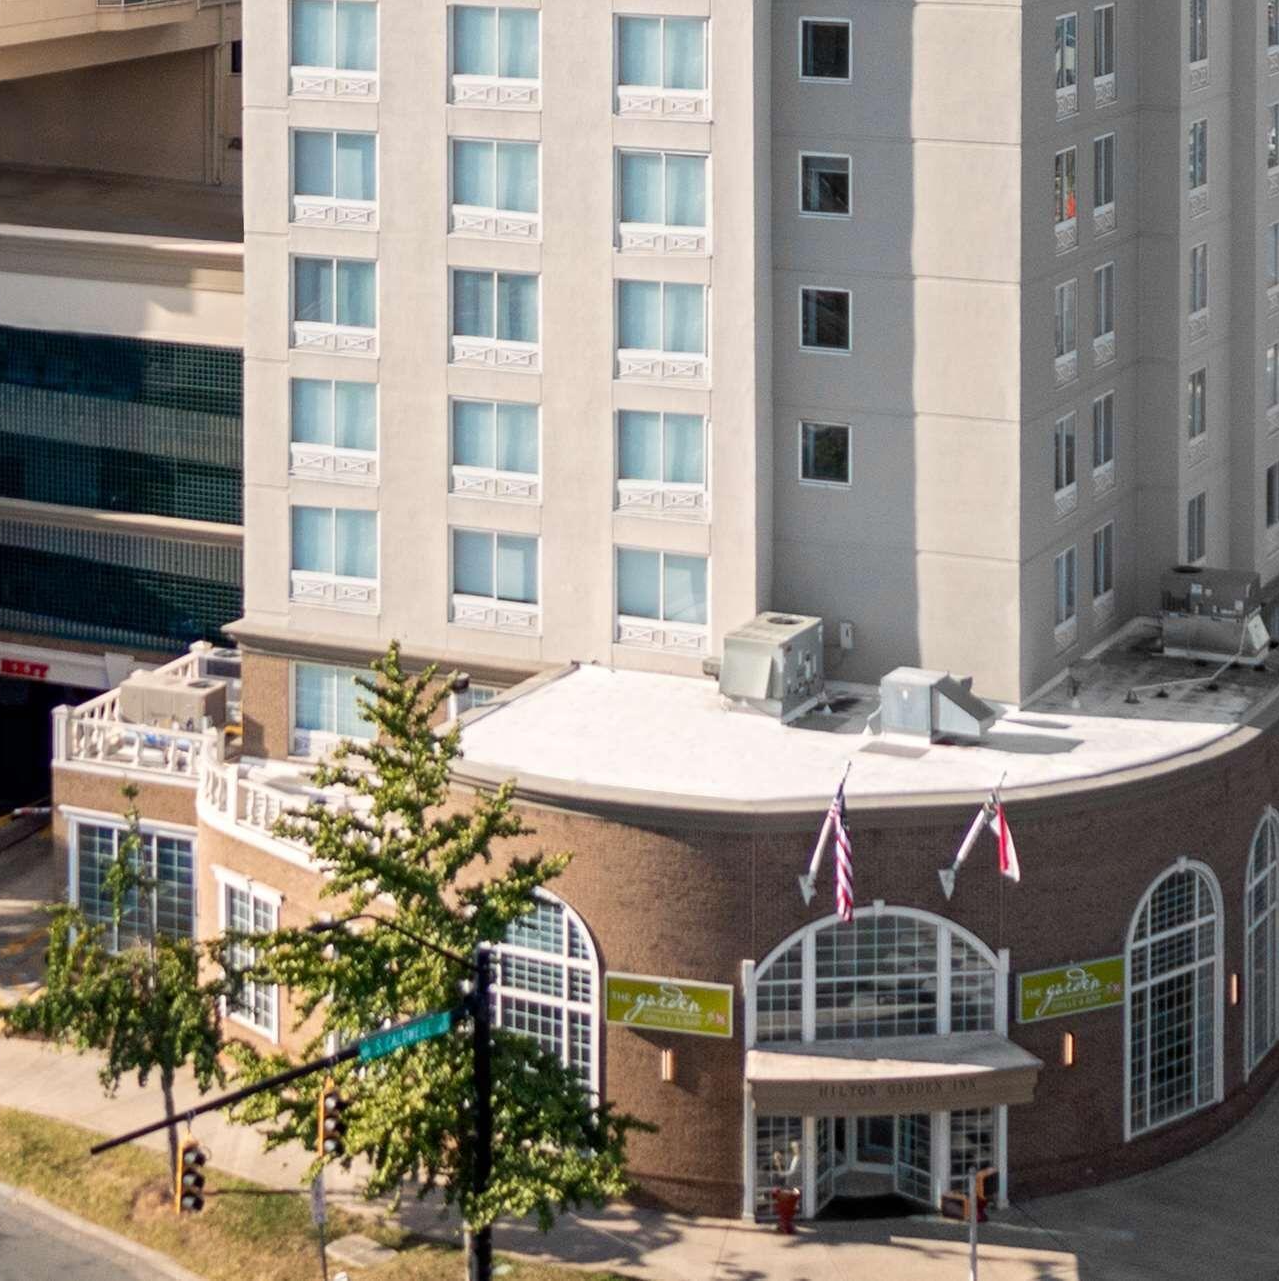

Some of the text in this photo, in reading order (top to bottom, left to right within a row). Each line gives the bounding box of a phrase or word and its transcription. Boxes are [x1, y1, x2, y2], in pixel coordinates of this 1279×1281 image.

[820, 1077, 977, 1099] HILTON GARDEN INN
